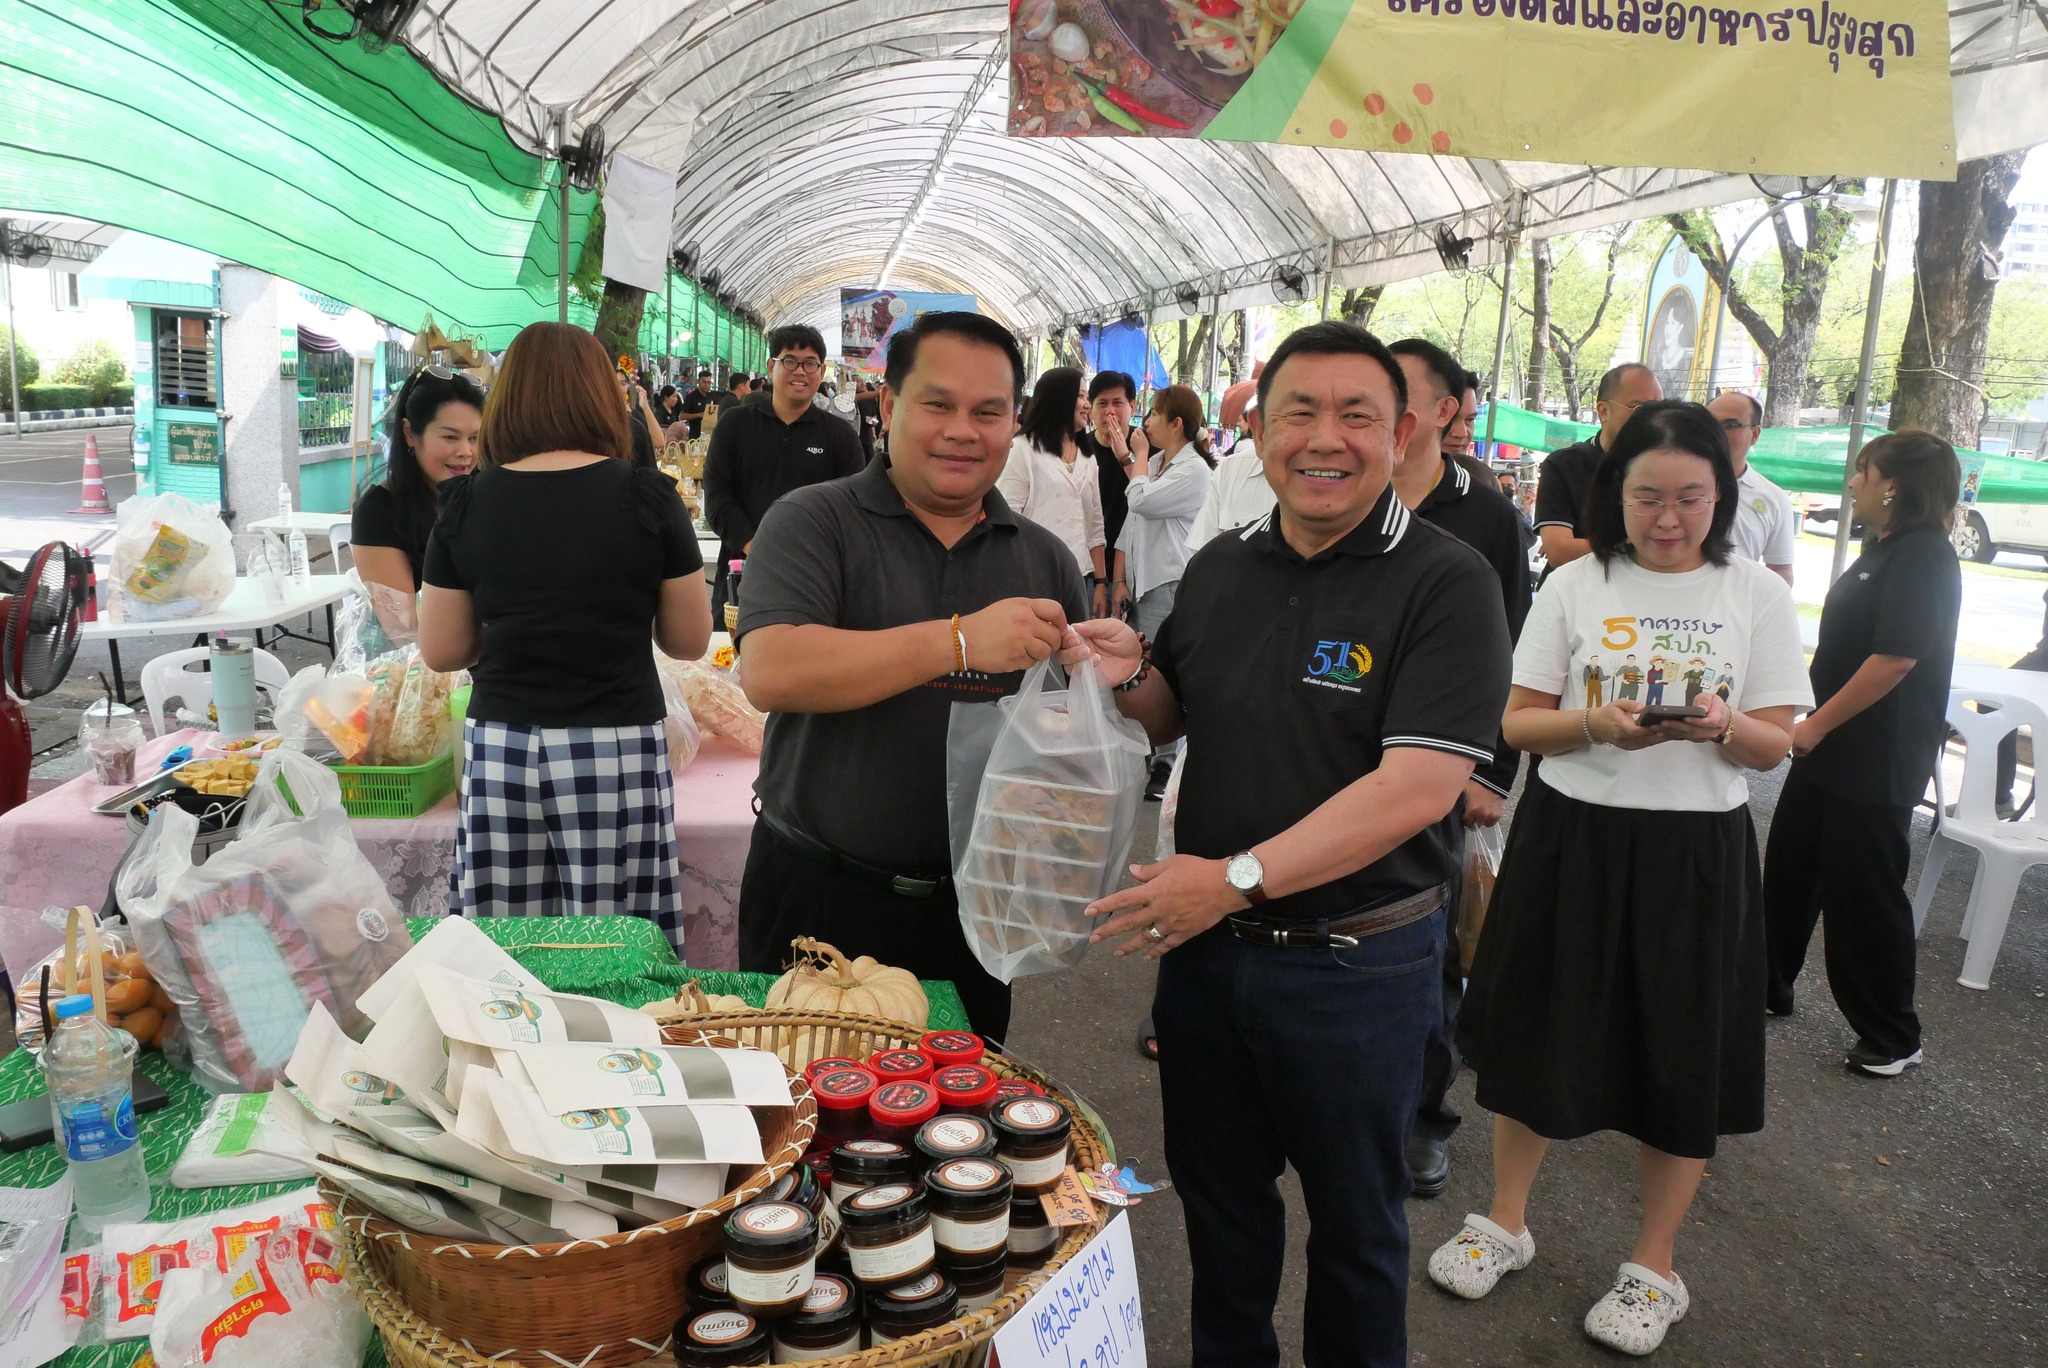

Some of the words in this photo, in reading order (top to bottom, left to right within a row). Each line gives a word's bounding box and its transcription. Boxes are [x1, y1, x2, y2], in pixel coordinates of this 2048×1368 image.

[1601, 616, 1638, 651] 5
[1639, 616, 1723, 635] ทศวรรษ
[1307, 640, 1351, 675] 51
[1651, 633, 1716, 656] ส.ป.ก.
